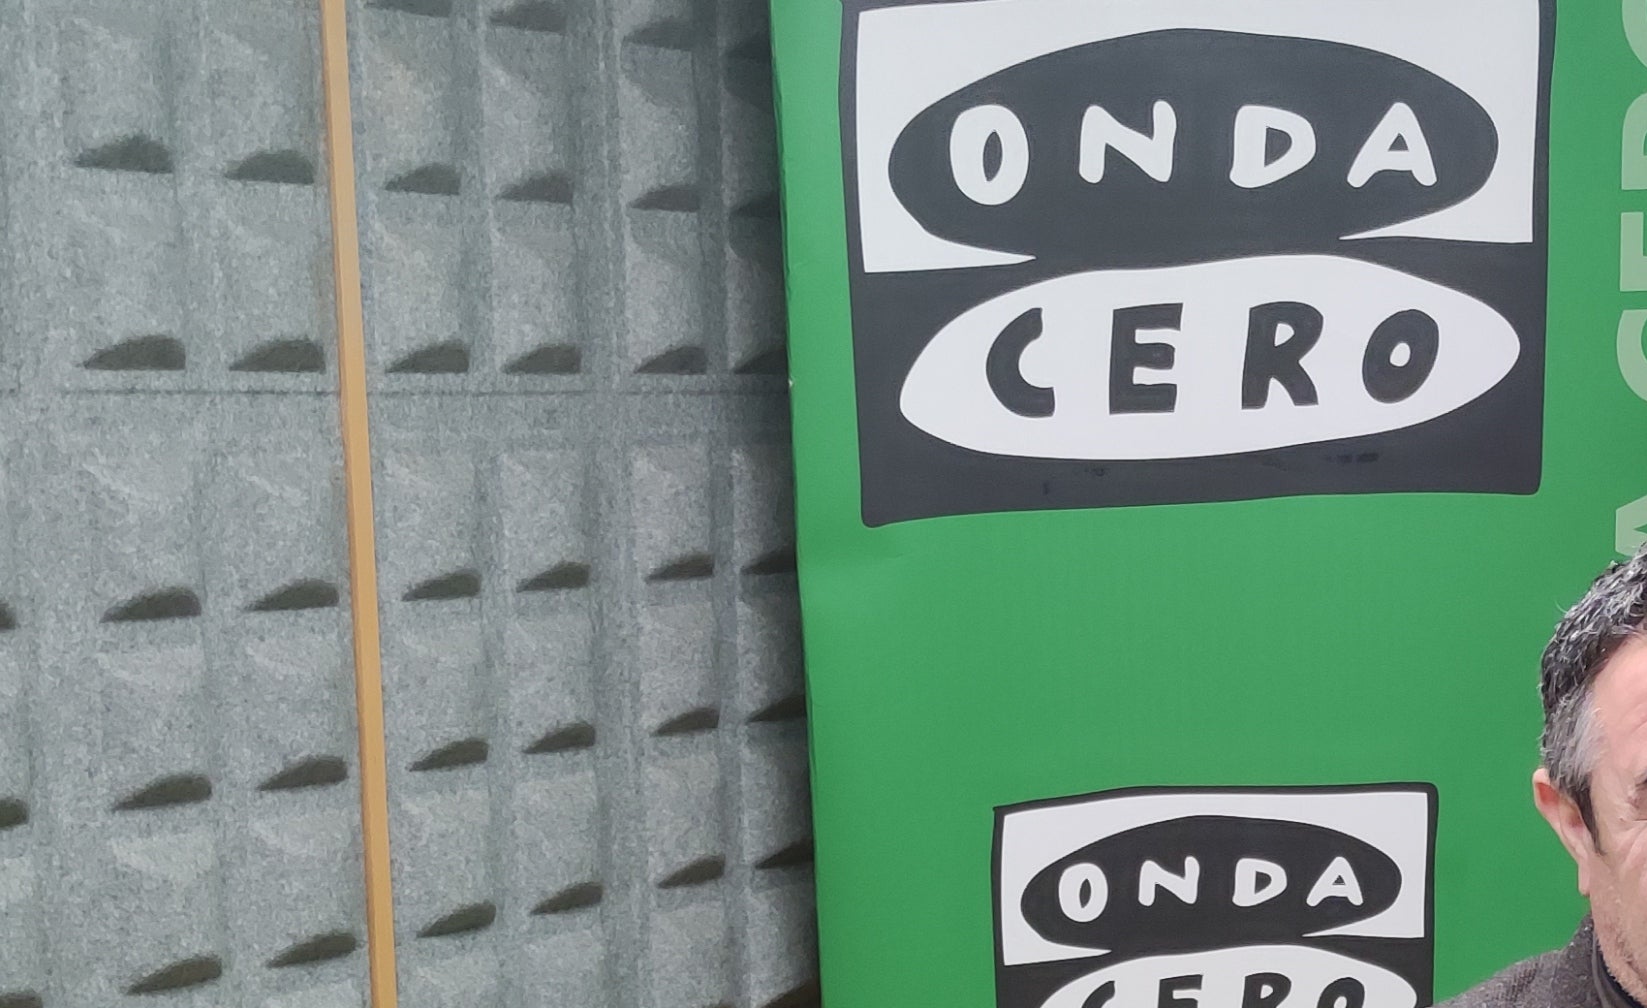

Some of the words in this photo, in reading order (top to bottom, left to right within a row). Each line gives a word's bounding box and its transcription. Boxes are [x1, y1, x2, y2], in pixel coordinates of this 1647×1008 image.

[949, 100, 1438, 206] ONDA
[985, 301, 1439, 418] CERO
[1058, 856, 1363, 923] ONDA
